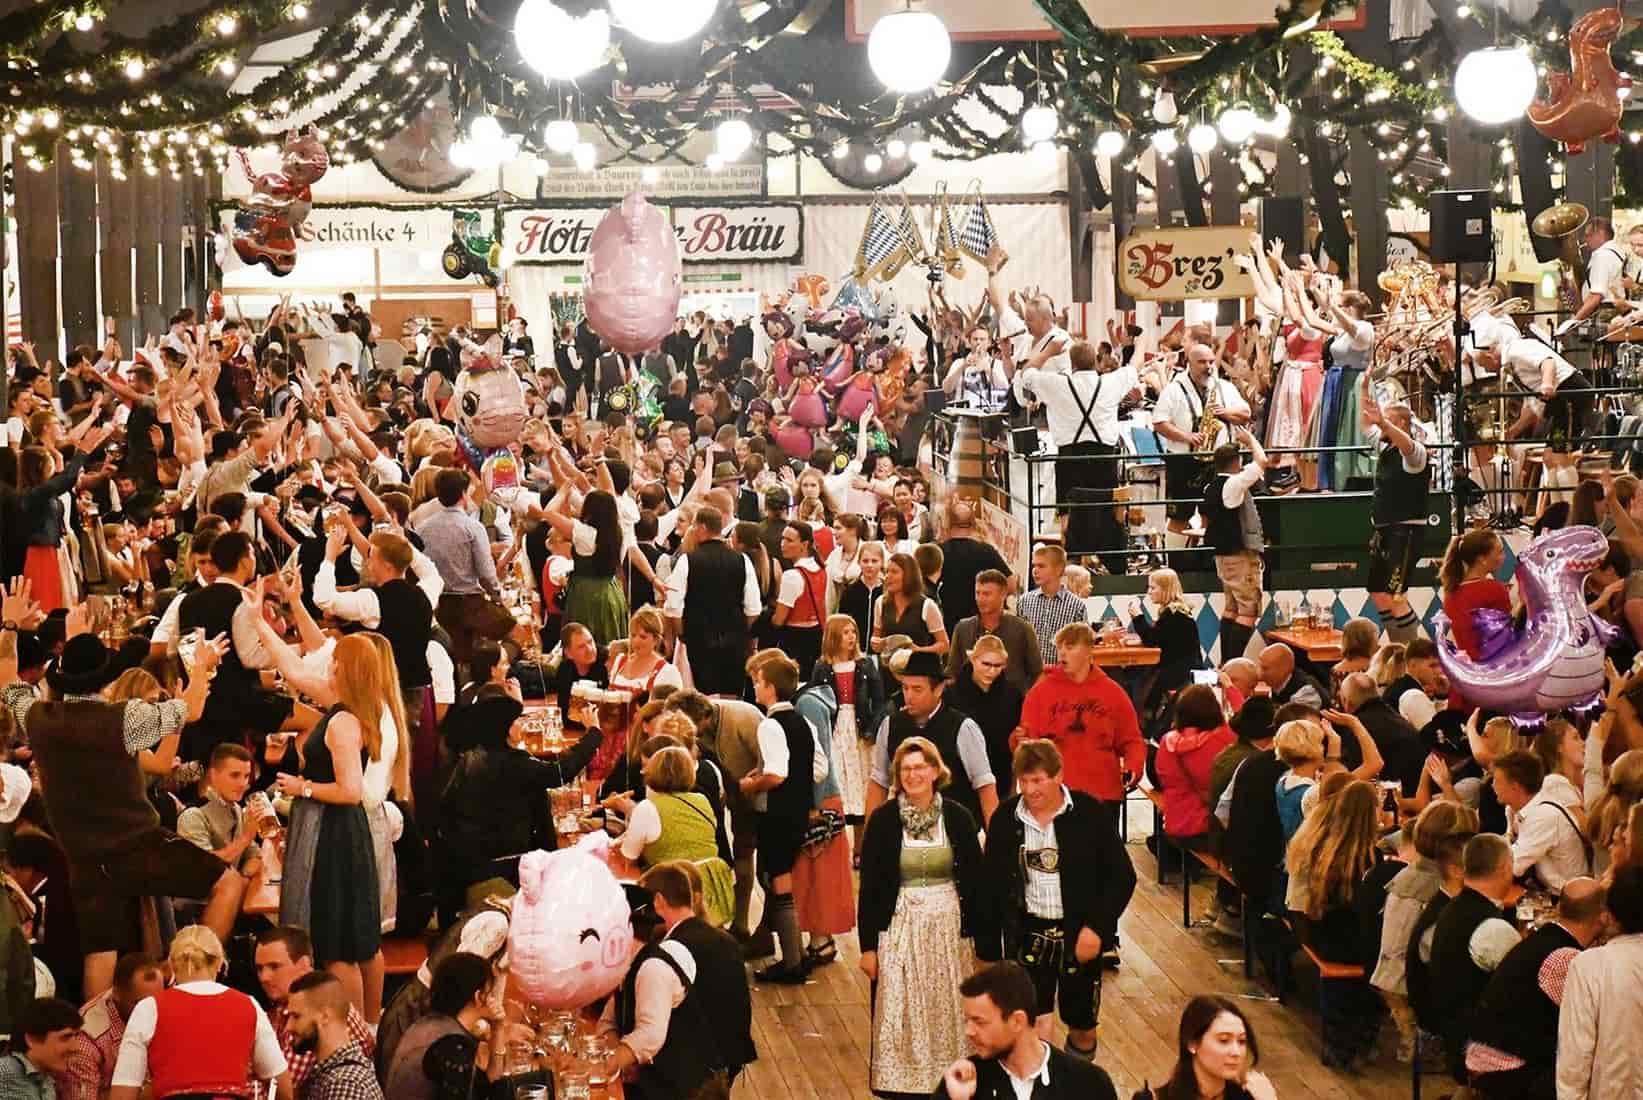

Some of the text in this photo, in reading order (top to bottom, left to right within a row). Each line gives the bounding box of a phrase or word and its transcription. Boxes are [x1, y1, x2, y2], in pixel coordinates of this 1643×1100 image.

[301, 221, 416, 242] Schänke 4
[1127, 240, 1260, 292] Brez'
